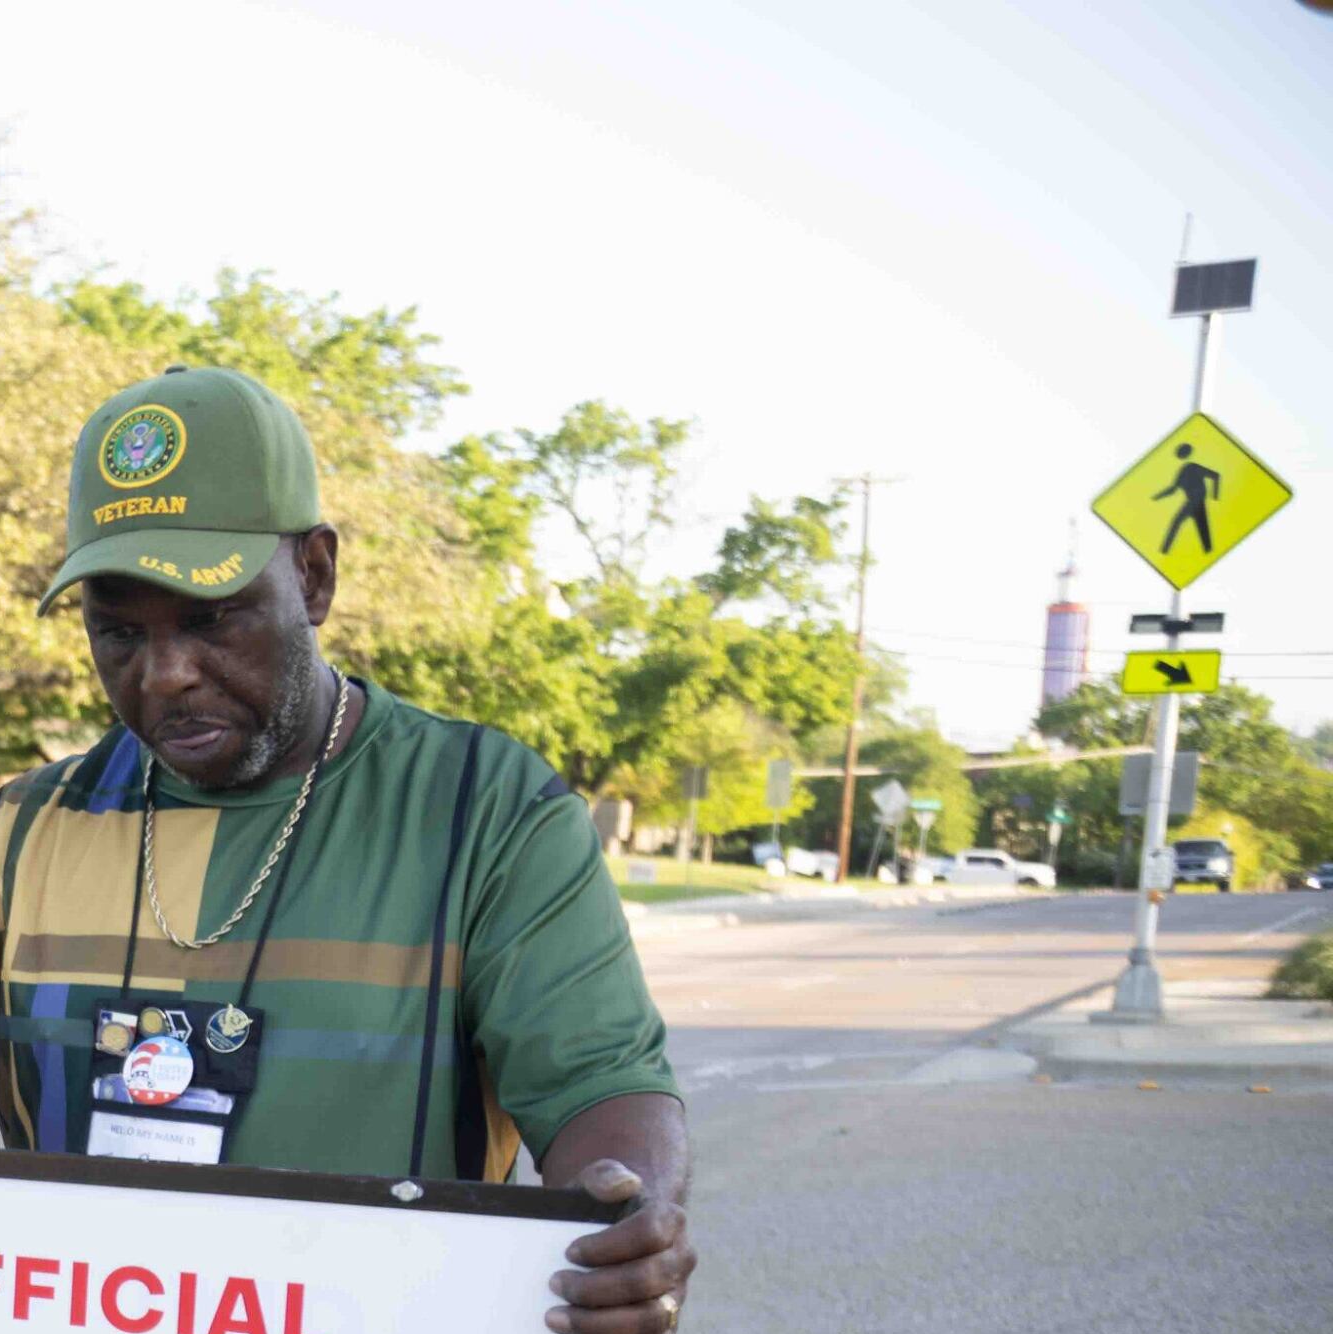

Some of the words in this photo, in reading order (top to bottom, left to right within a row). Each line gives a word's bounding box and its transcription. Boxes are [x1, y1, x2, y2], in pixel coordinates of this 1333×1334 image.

[93, 496, 187, 525] VETERAN
[138, 555, 183, 579] U.S.
[190, 552, 242, 586] ARMY
